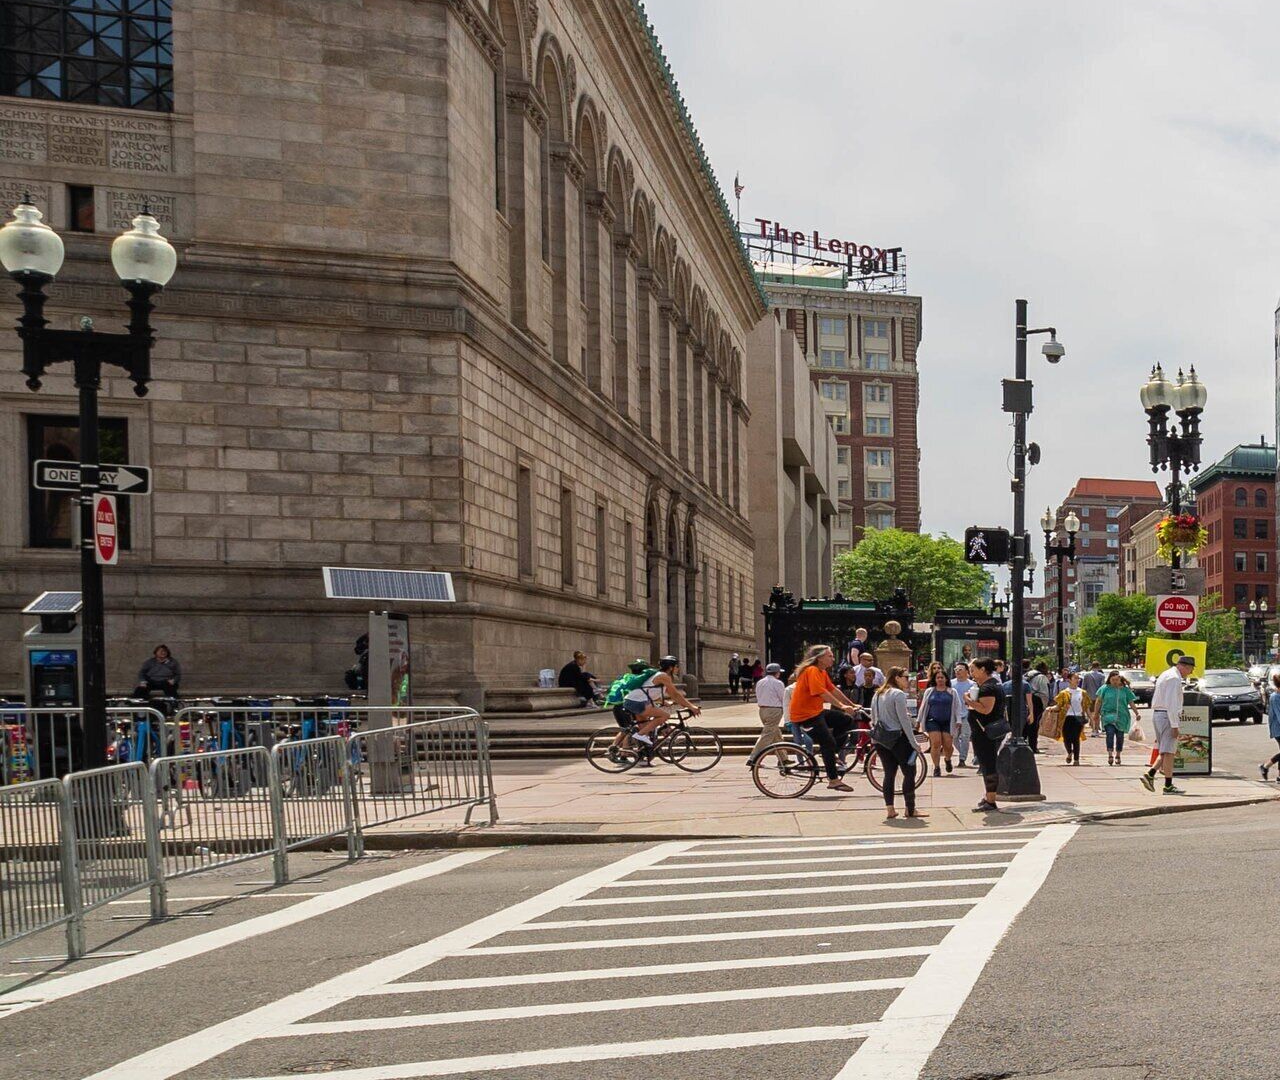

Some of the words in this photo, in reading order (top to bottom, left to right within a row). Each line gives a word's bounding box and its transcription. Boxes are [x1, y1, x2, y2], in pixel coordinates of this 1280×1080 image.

[111, 140, 169, 153] MARLOWE
[111, 150, 161, 162] JONSON
[111, 160, 168, 172] SHERIDAN
[755, 218, 805, 246] The
[813, 230, 887, 262] Lenox
[48, 469, 79, 481] ONE
[1164, 602, 1174, 610] DO
[1176, 603, 1189, 611] NOT
[1165, 618, 1187, 626] ENTER
